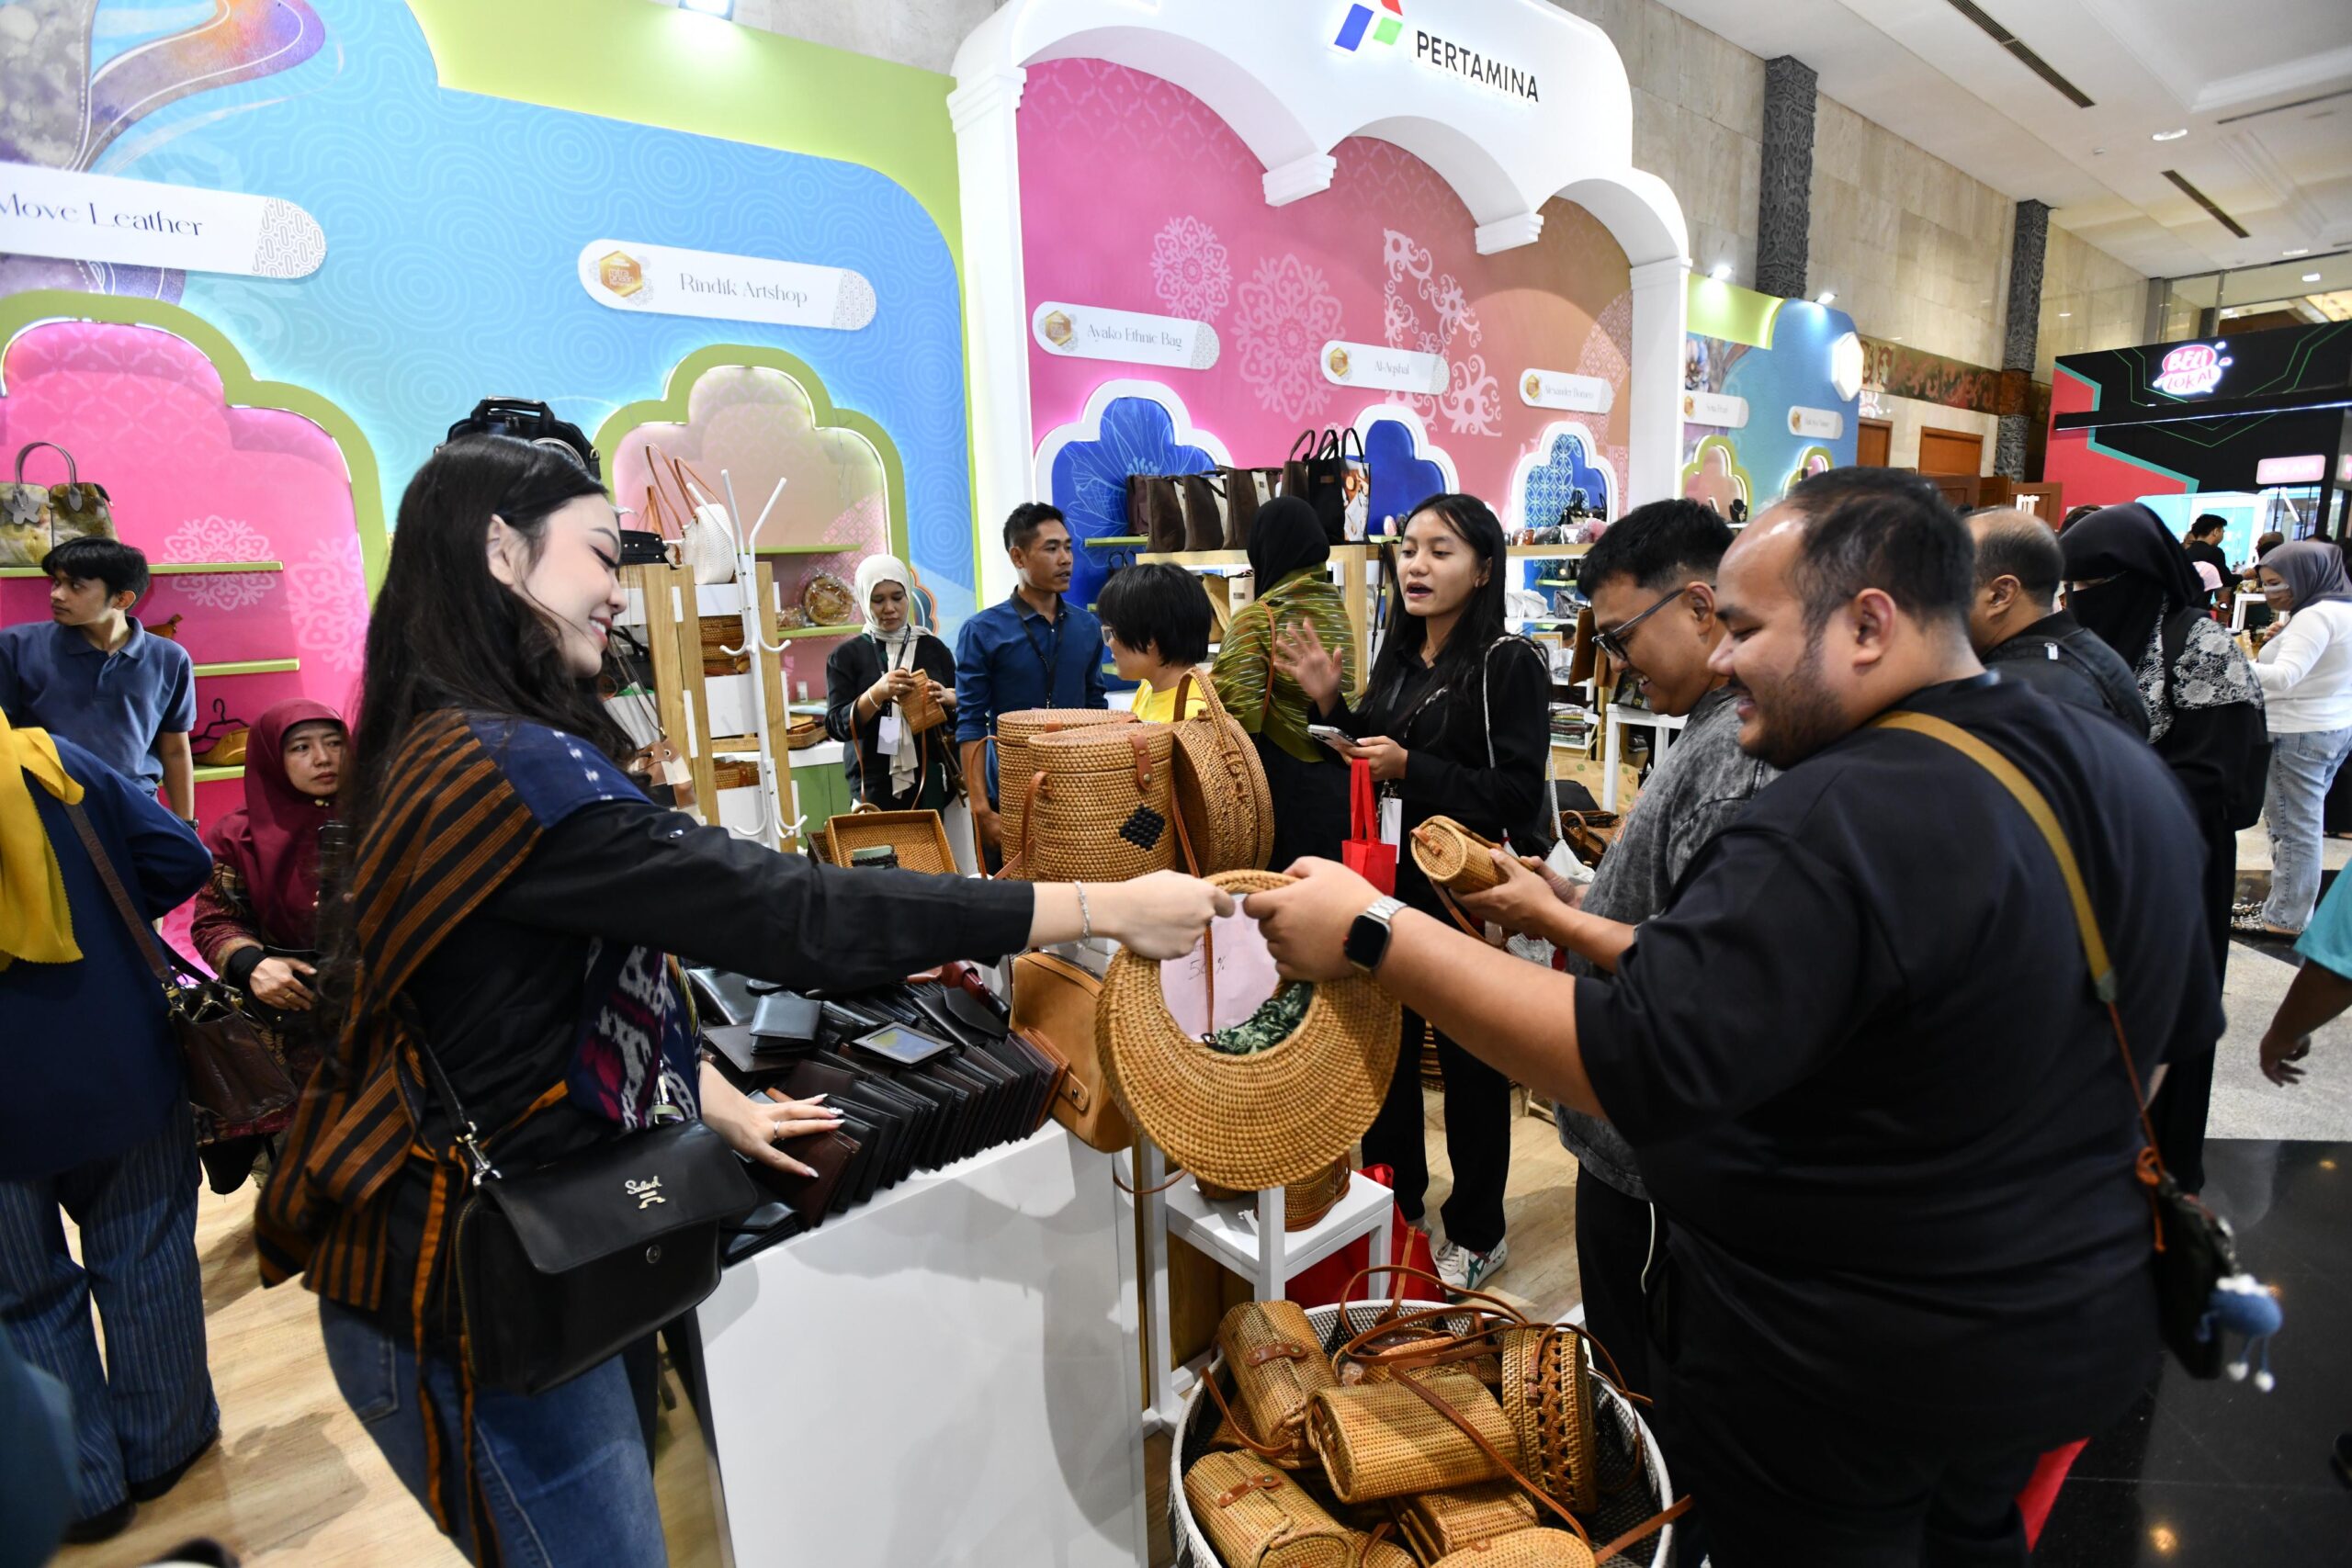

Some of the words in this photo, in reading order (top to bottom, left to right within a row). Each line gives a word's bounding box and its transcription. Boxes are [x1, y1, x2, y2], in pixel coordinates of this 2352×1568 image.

[1417, 29, 1539, 103] PERTAMINA
[89, 202, 203, 236] Leather
[680, 273, 738, 296] Rindik
[742, 281, 808, 308] Artshop
[1087, 324, 1123, 343] Ayako
[1125, 328, 1159, 344] Ethnic
[1161, 333, 1182, 351] Bag
